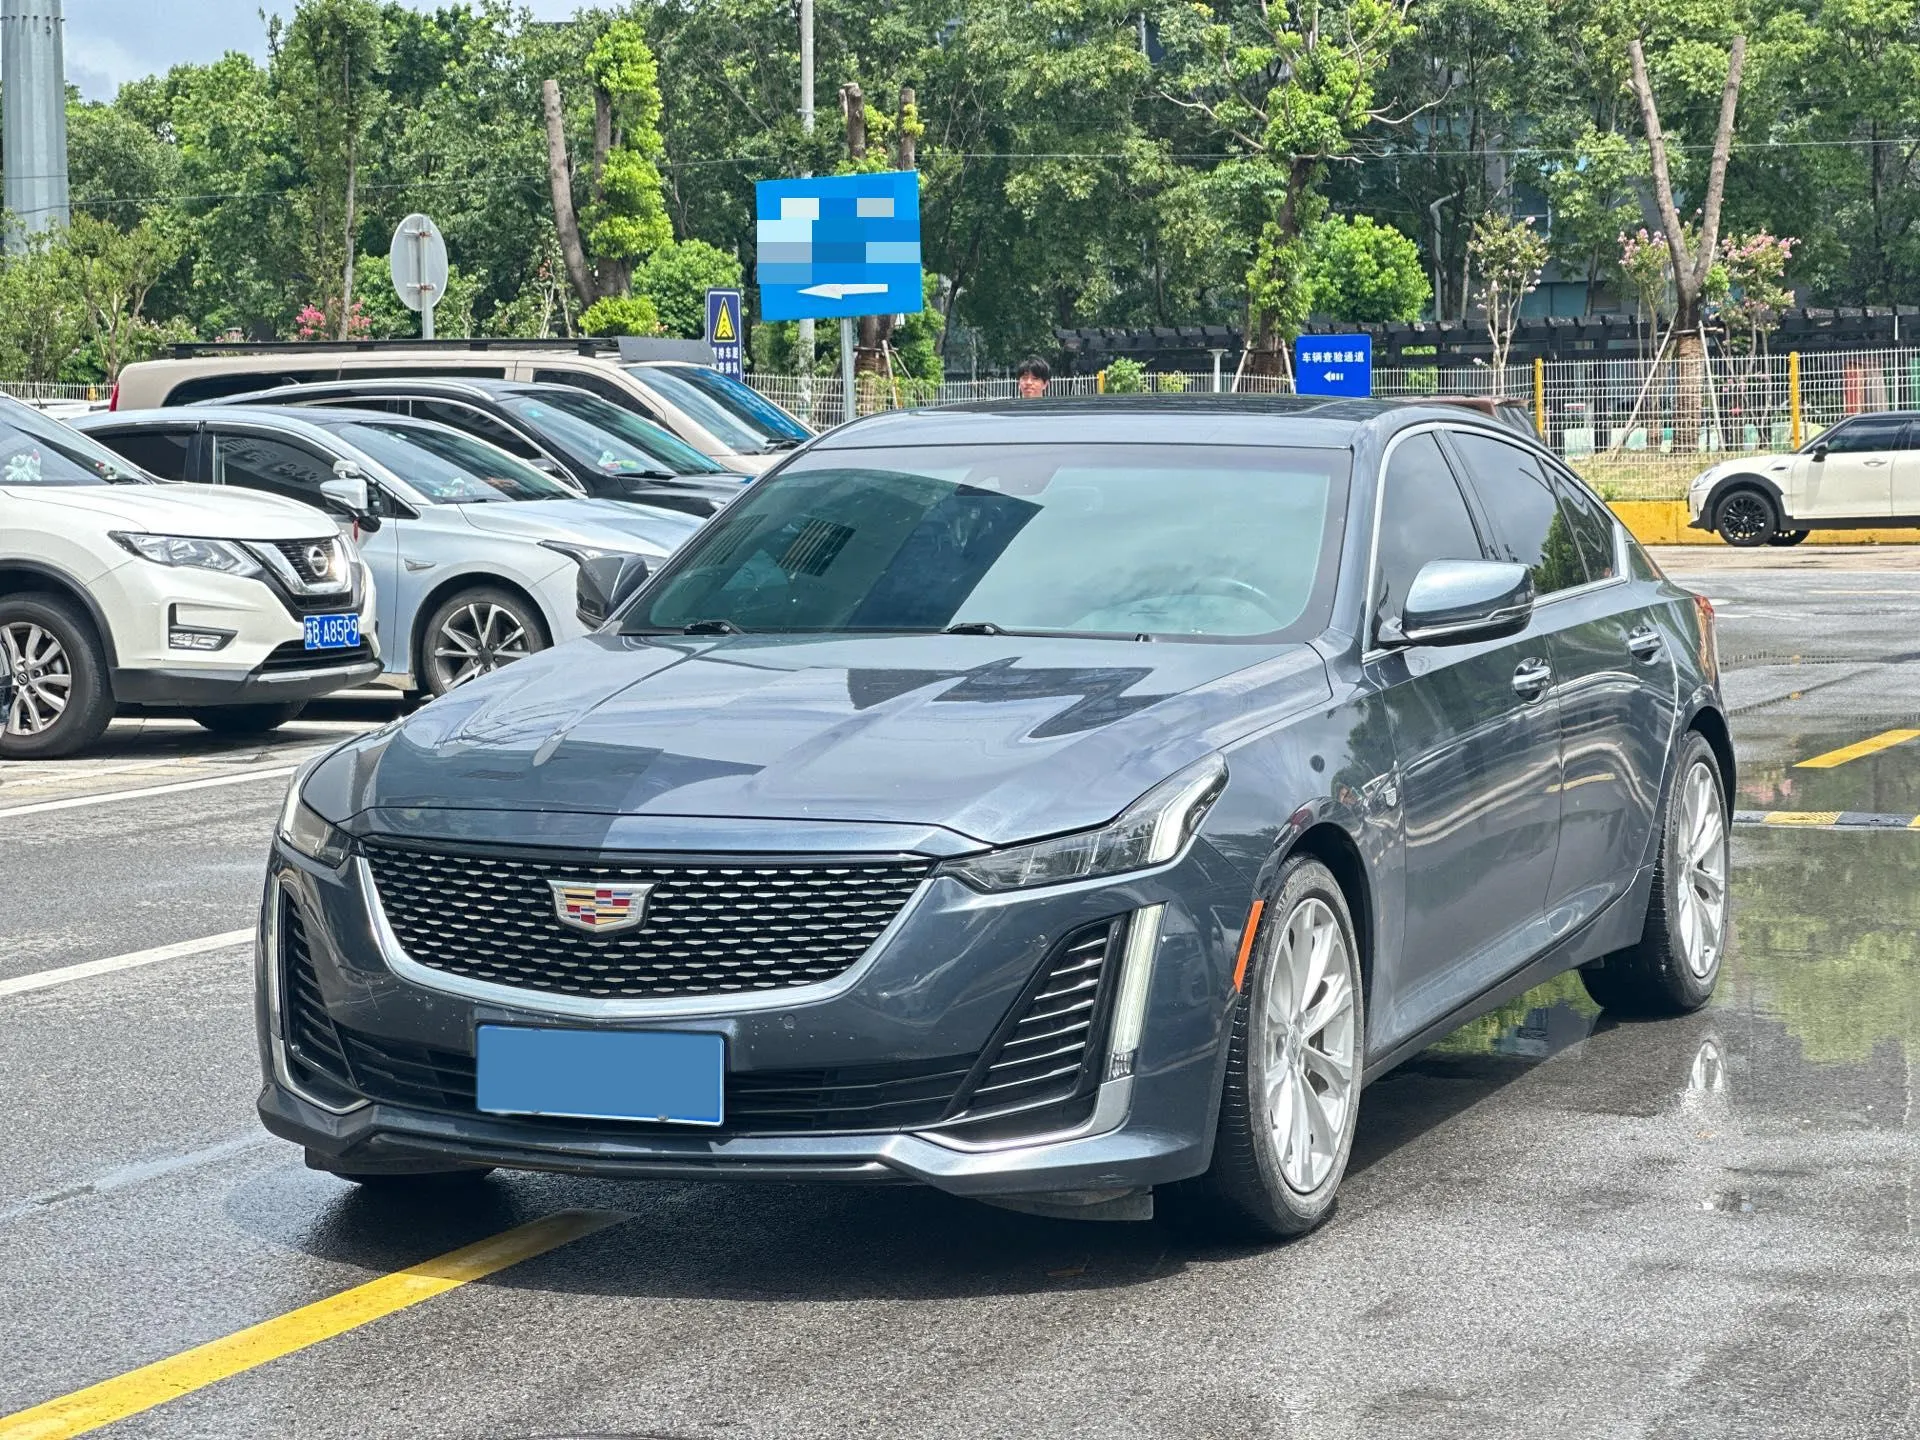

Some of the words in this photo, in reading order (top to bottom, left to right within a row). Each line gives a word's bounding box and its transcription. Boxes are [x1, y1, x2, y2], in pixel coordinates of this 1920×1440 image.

[1302, 350, 1365, 363] 车辆查验通道
